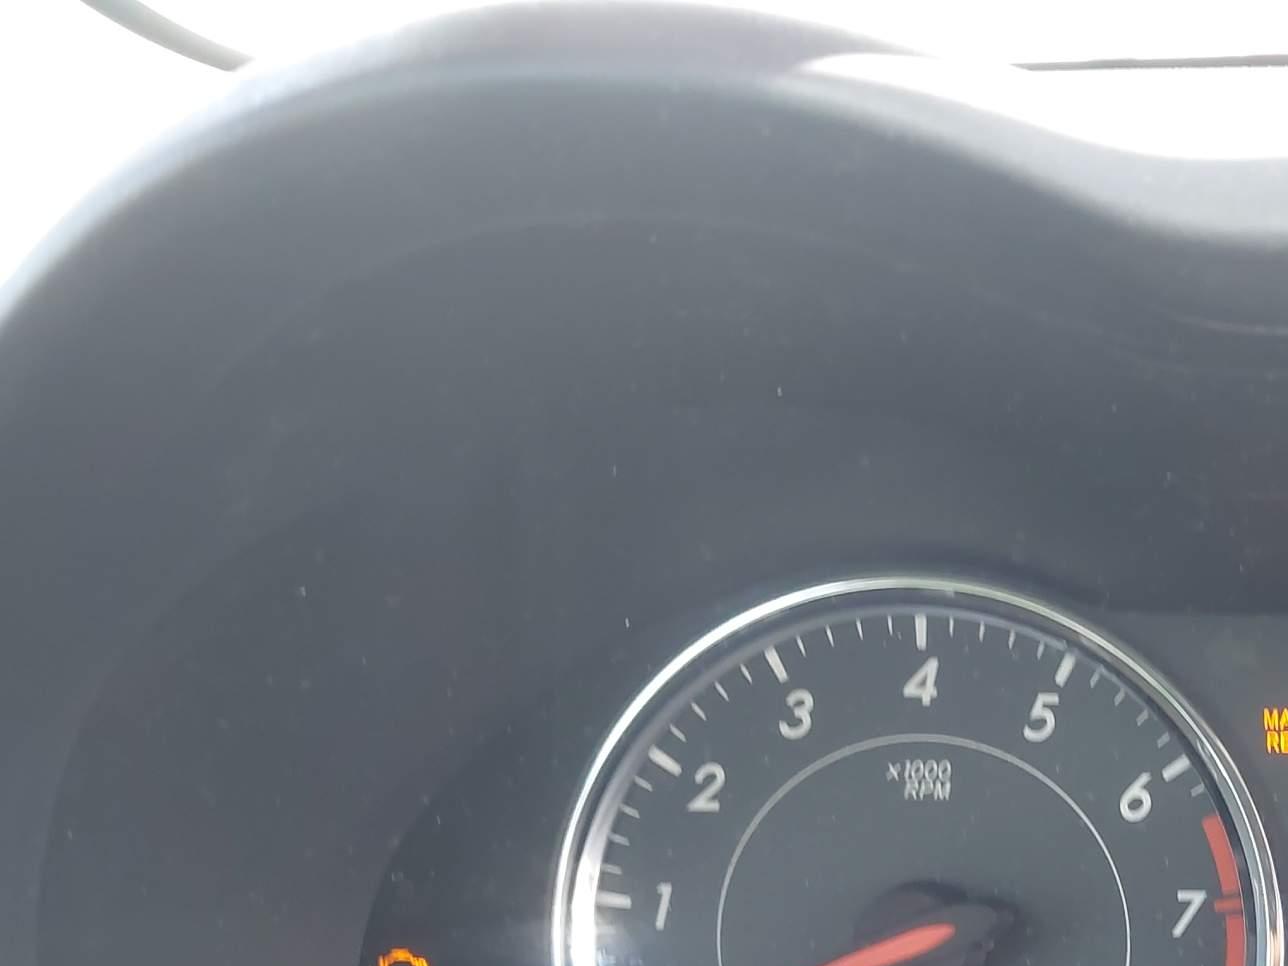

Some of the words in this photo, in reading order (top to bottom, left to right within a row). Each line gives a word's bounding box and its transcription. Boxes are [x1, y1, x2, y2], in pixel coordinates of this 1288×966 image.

[904, 658, 938, 706] 4
[779, 690, 814, 740] 3
[1023, 692, 1060, 742] 5
[687, 762, 727, 812] 2
[904, 779, 951, 801] RPM
[1118, 774, 1152, 822] 6
[655, 882, 673, 931] 1
[1172, 889, 1208, 938] 7
